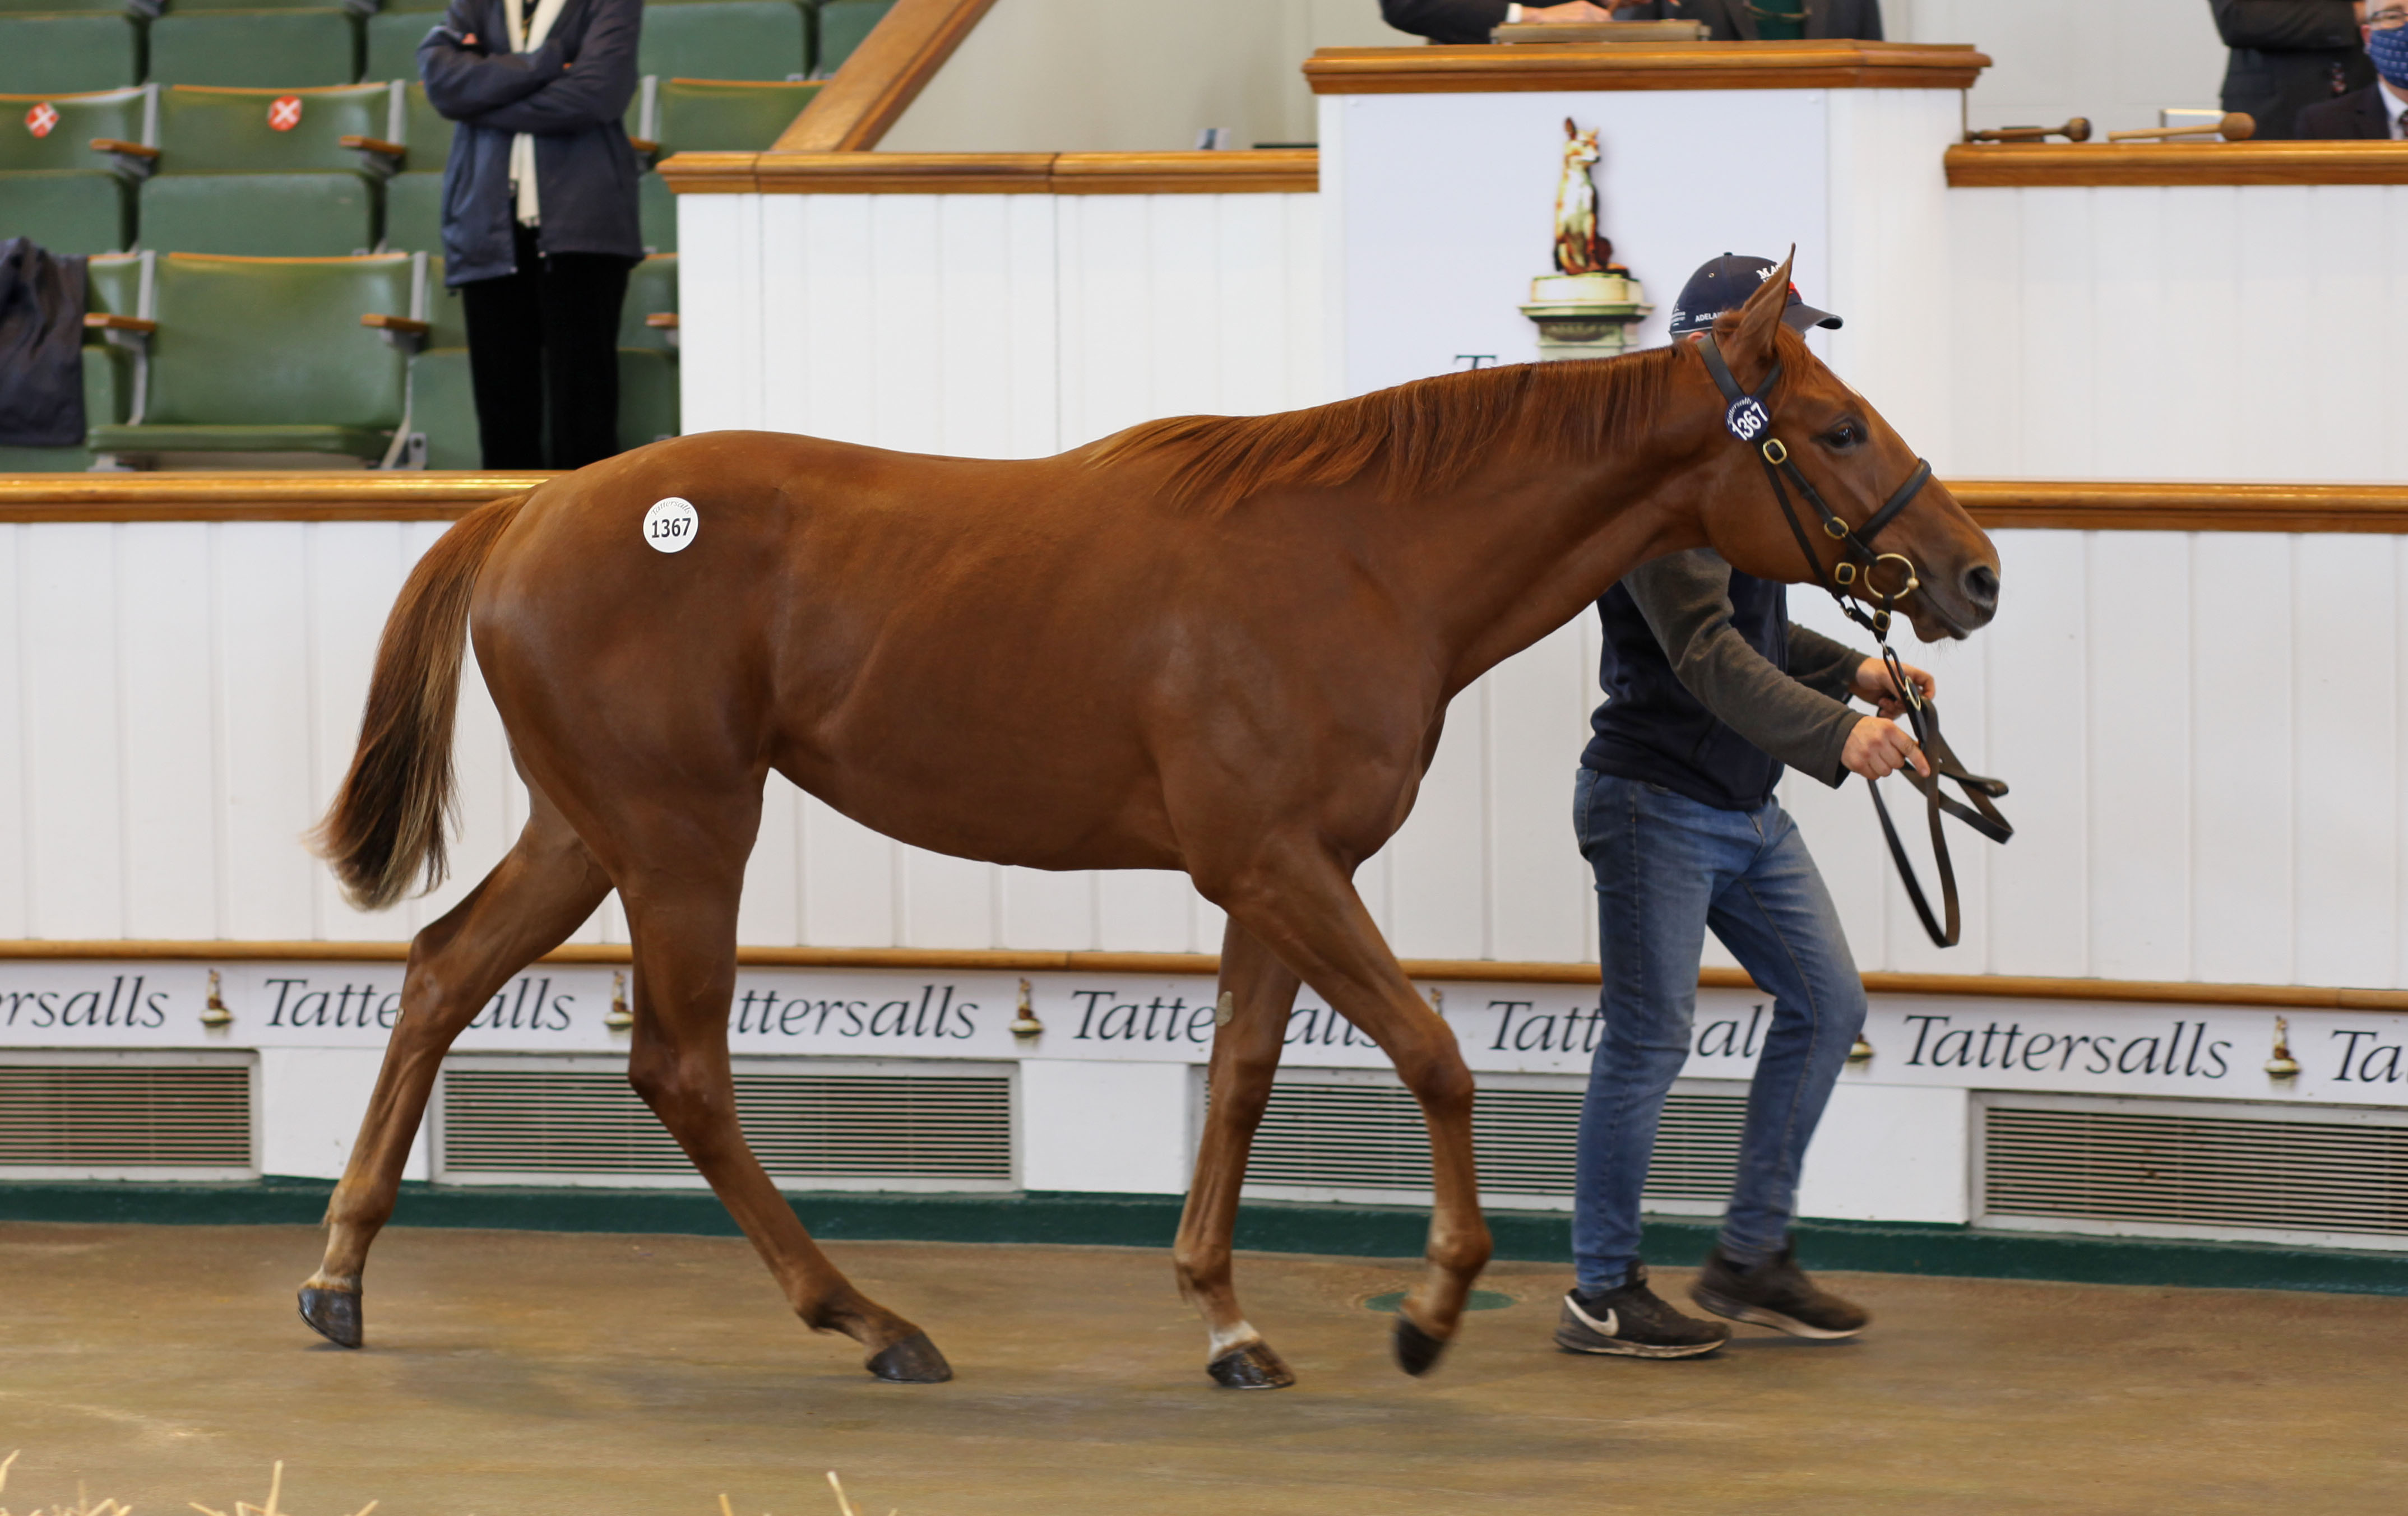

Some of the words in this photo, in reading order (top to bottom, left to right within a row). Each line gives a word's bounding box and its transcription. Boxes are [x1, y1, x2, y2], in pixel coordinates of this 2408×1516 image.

[1732, 401, 1768, 441] 1367
[651, 500, 691, 516] Tattersalls
[651, 517, 691, 538] 1367
[0, 975, 169, 1027] rsalls
[263, 979, 575, 1031] Tattealls
[729, 985, 979, 1039] ttersalls
[1488, 1000, 1764, 1058] Tattal
[1904, 1015, 2233, 1078] Tattersalls
[2330, 1030, 2408, 1083] Ta
